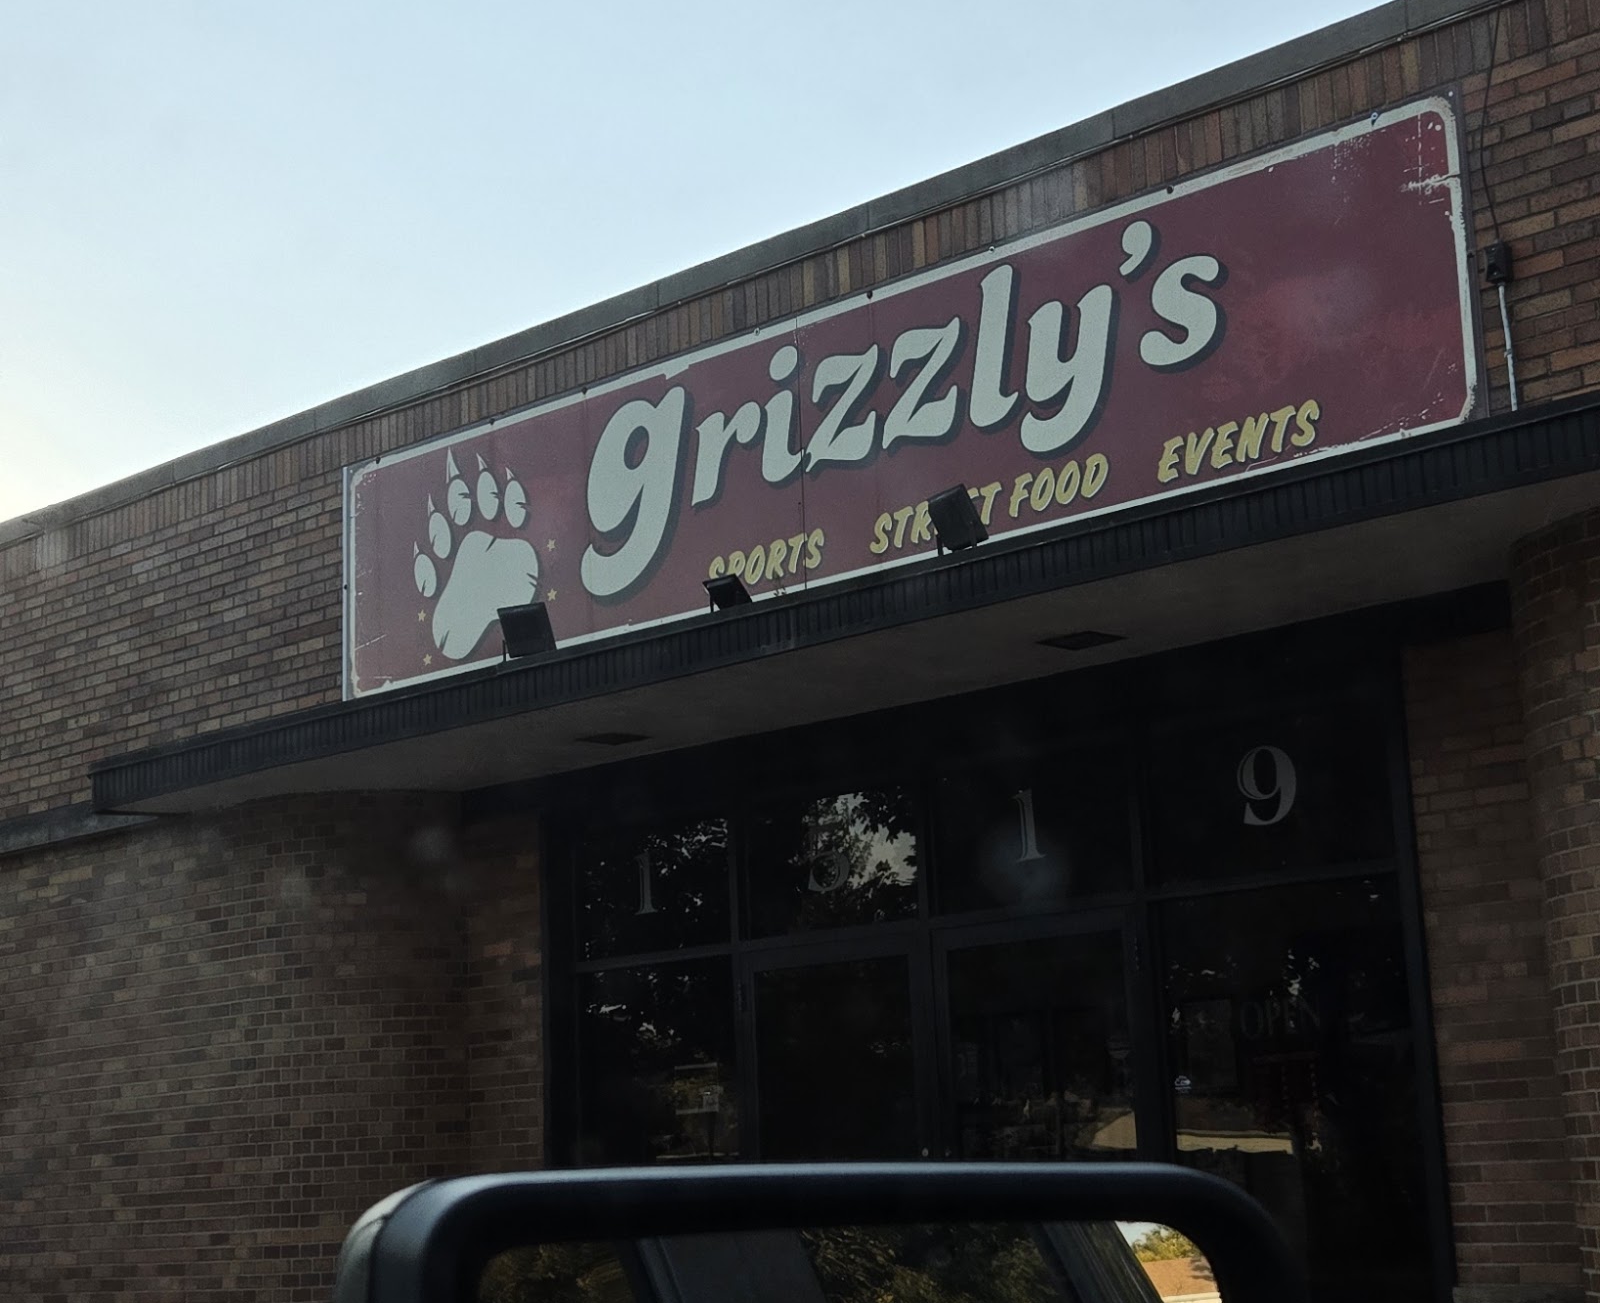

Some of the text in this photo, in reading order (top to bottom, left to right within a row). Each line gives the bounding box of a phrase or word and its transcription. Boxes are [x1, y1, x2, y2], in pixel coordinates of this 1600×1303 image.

[579, 219, 1224, 597] grizzly's
[869, 481, 1002, 554] STRT
[1008, 452, 1109, 518] FOOD
[1157, 399, 1320, 483] EVENTS
